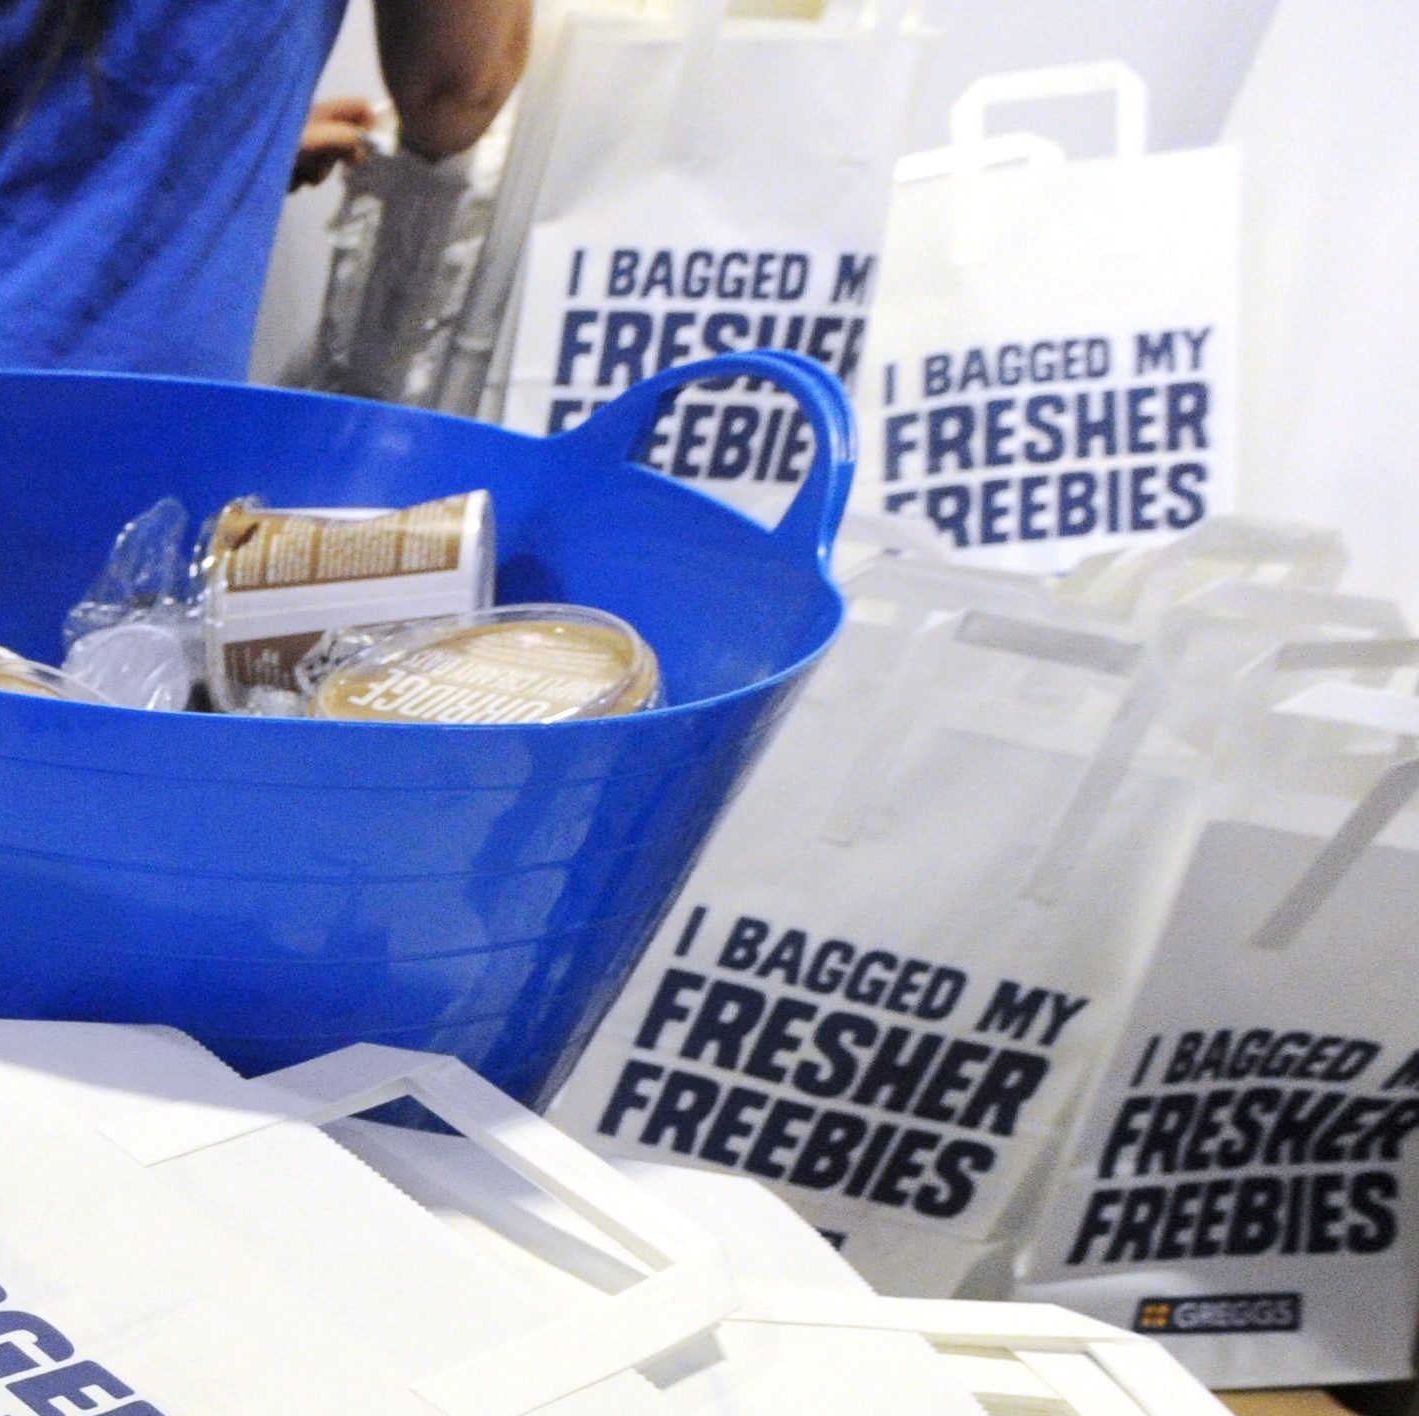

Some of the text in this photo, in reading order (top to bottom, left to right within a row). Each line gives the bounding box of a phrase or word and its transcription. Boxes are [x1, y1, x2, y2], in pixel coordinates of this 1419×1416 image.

[568, 249, 877, 304] I BAGGED M
[884, 326, 1211, 405] I BAGGED MY
[884, 381, 1209, 481] FRESHER
[674, 905, 1090, 1047] I BAGGED MY
[634, 968, 1051, 1137] FRESHER
[1131, 1034, 1160, 1088] I
[1164, 1028, 1384, 1084] BAGGED
[597, 1058, 997, 1219] FREEBIES
[1098, 1087, 1419, 1180] FRESHER
[1065, 1171, 1399, 1266] FREEBIES
[1174, 1302, 1294, 1329] GREGGS
